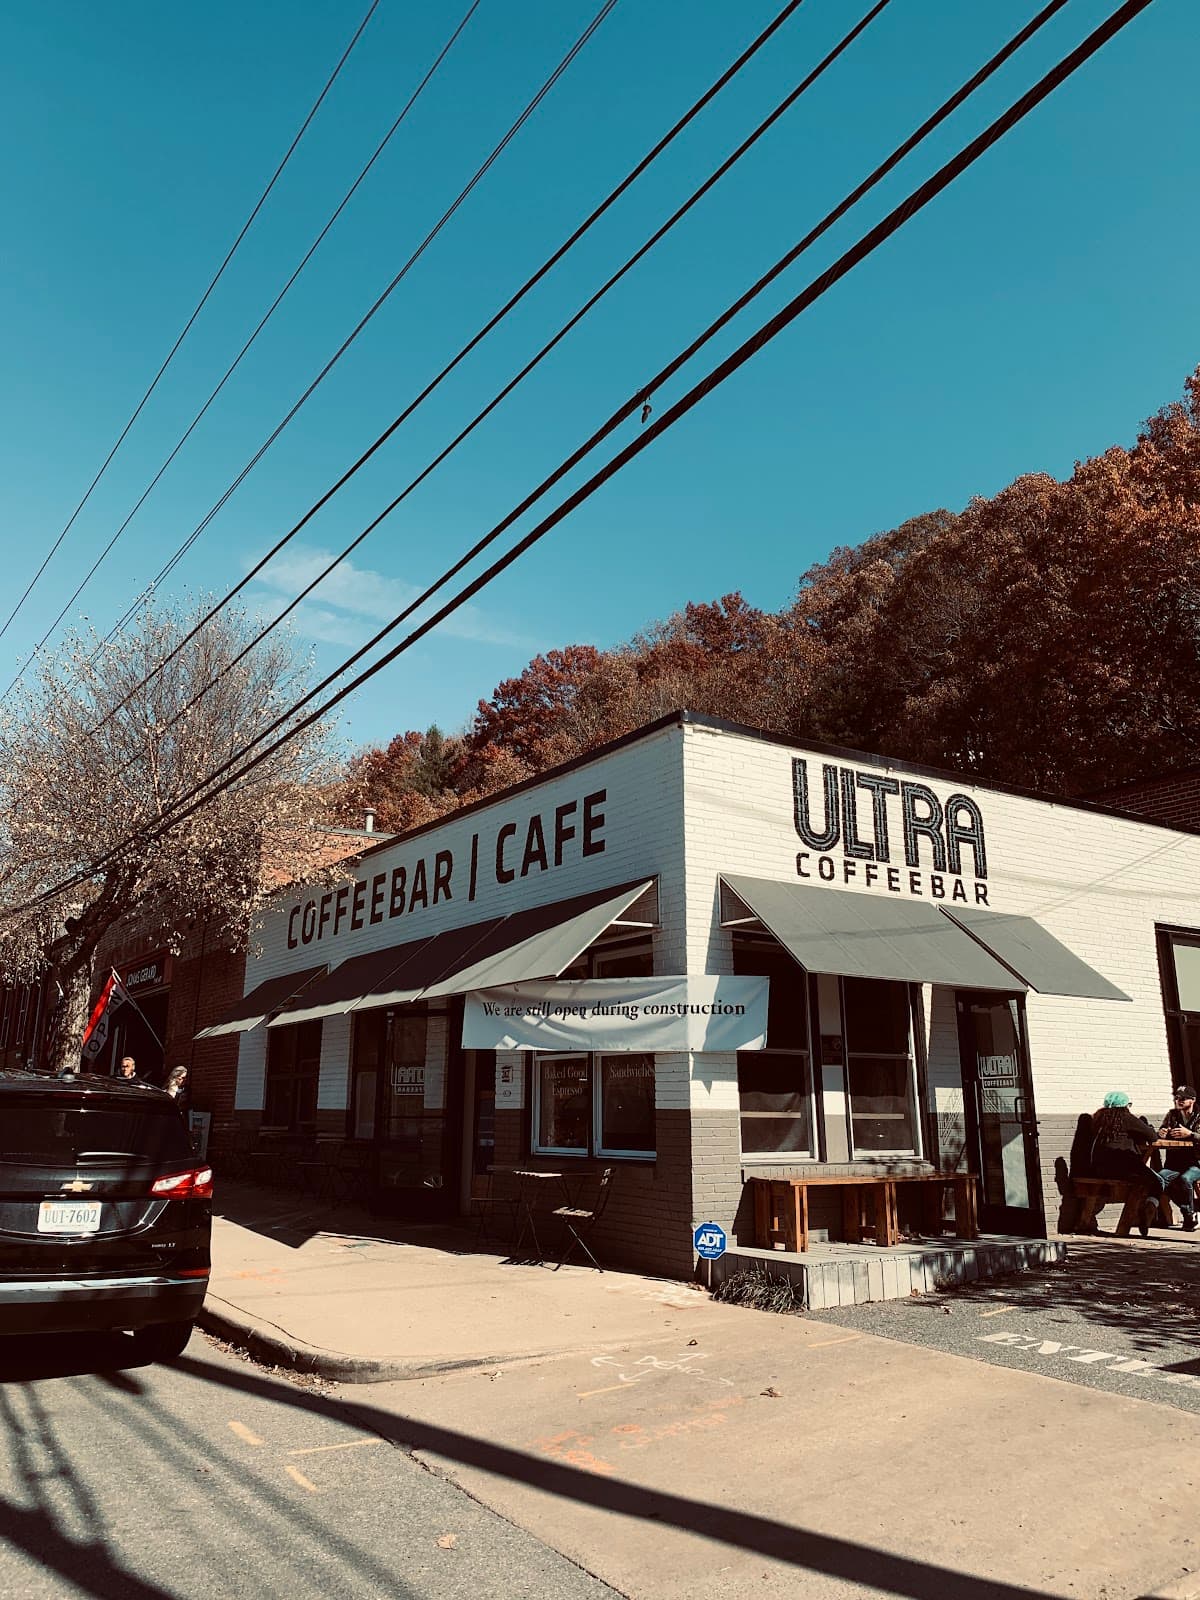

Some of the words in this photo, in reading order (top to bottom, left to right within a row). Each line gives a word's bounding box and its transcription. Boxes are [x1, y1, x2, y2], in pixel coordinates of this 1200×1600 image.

[791, 756, 988, 881] ULTRA
[287, 849, 453, 950] COFFEEBAR
[495, 788, 608, 885] CAFE
[795, 852, 991, 907] COFFEEBAR
[483, 1002, 500, 1017] We
[504, 1006, 522, 1017] are
[525, 1002, 550, 1017] still
[554, 1006, 587, 1021] open
[592, 1001, 639, 1021] during
[643, 999, 746, 1016] construction
[552, 1082, 584, 1100] Espresso
[696, 1232, 724, 1248] ADT
